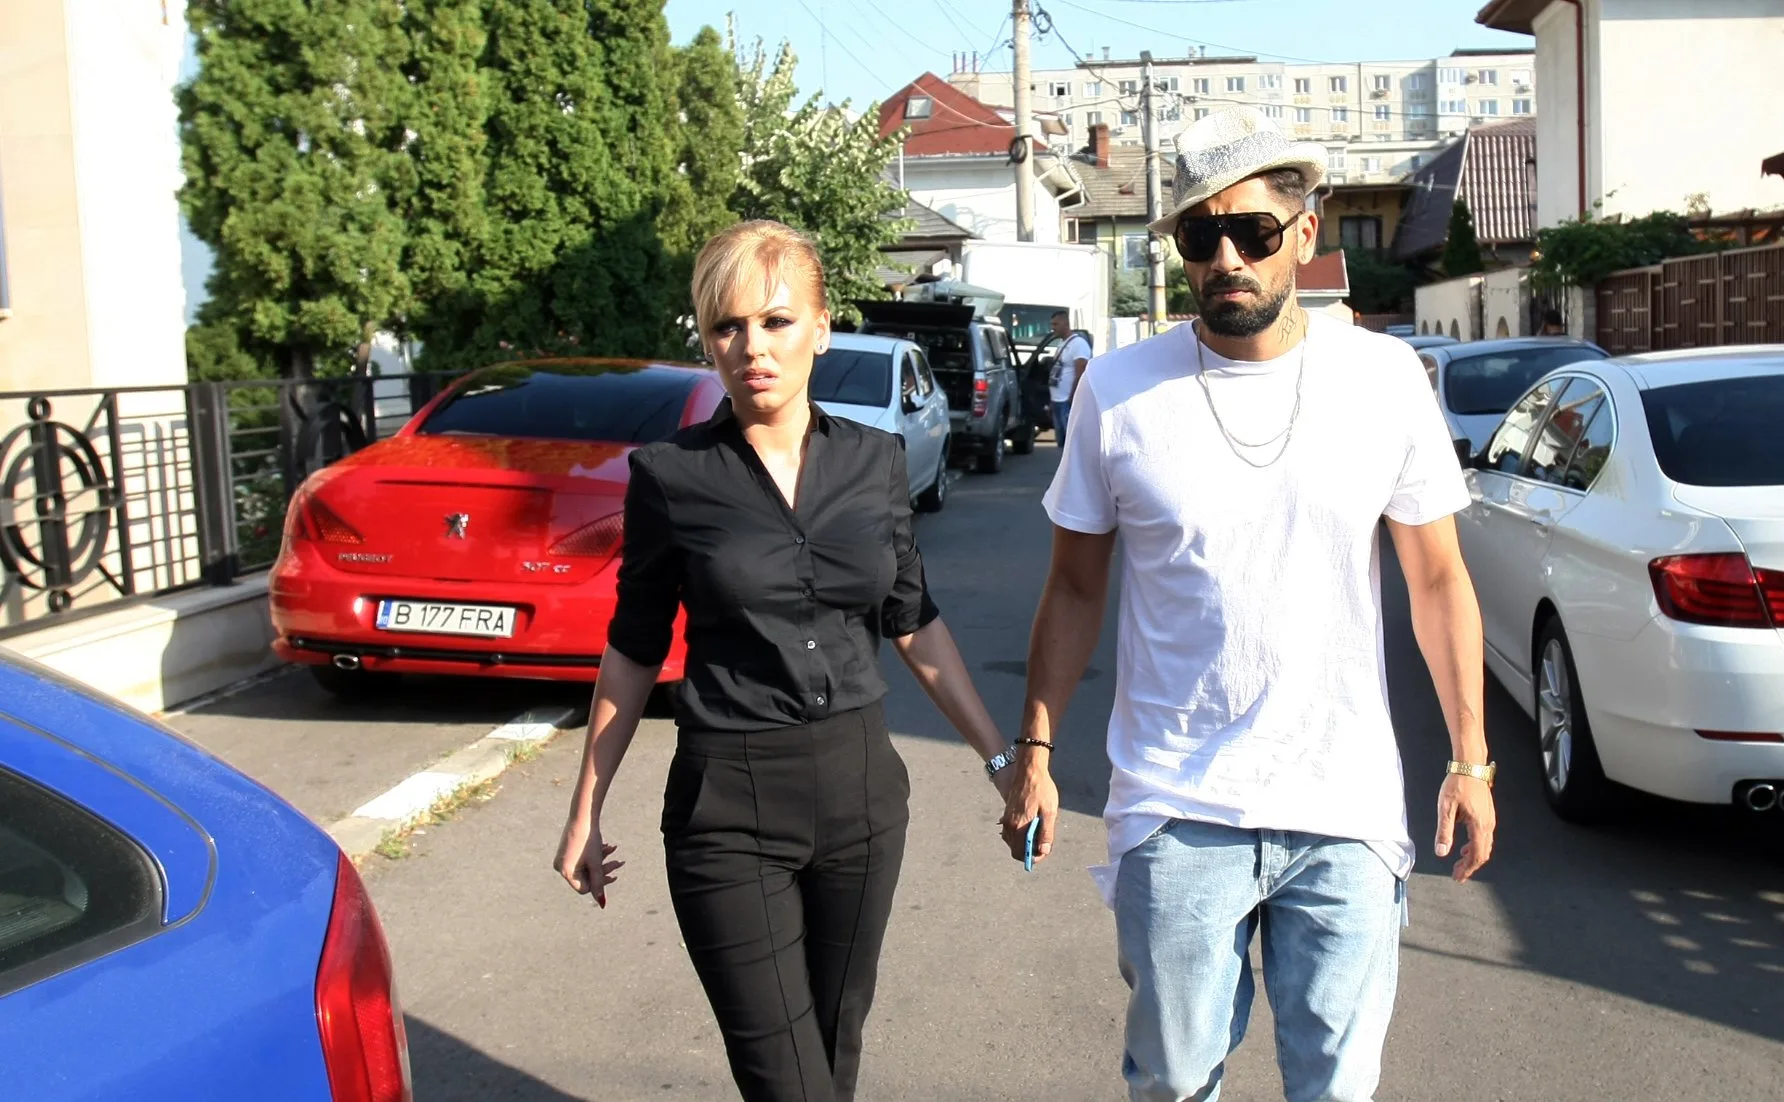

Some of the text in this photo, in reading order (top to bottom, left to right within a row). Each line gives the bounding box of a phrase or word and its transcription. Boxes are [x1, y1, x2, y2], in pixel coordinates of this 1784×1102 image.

[394, 603, 504, 632] B 177 FRA
